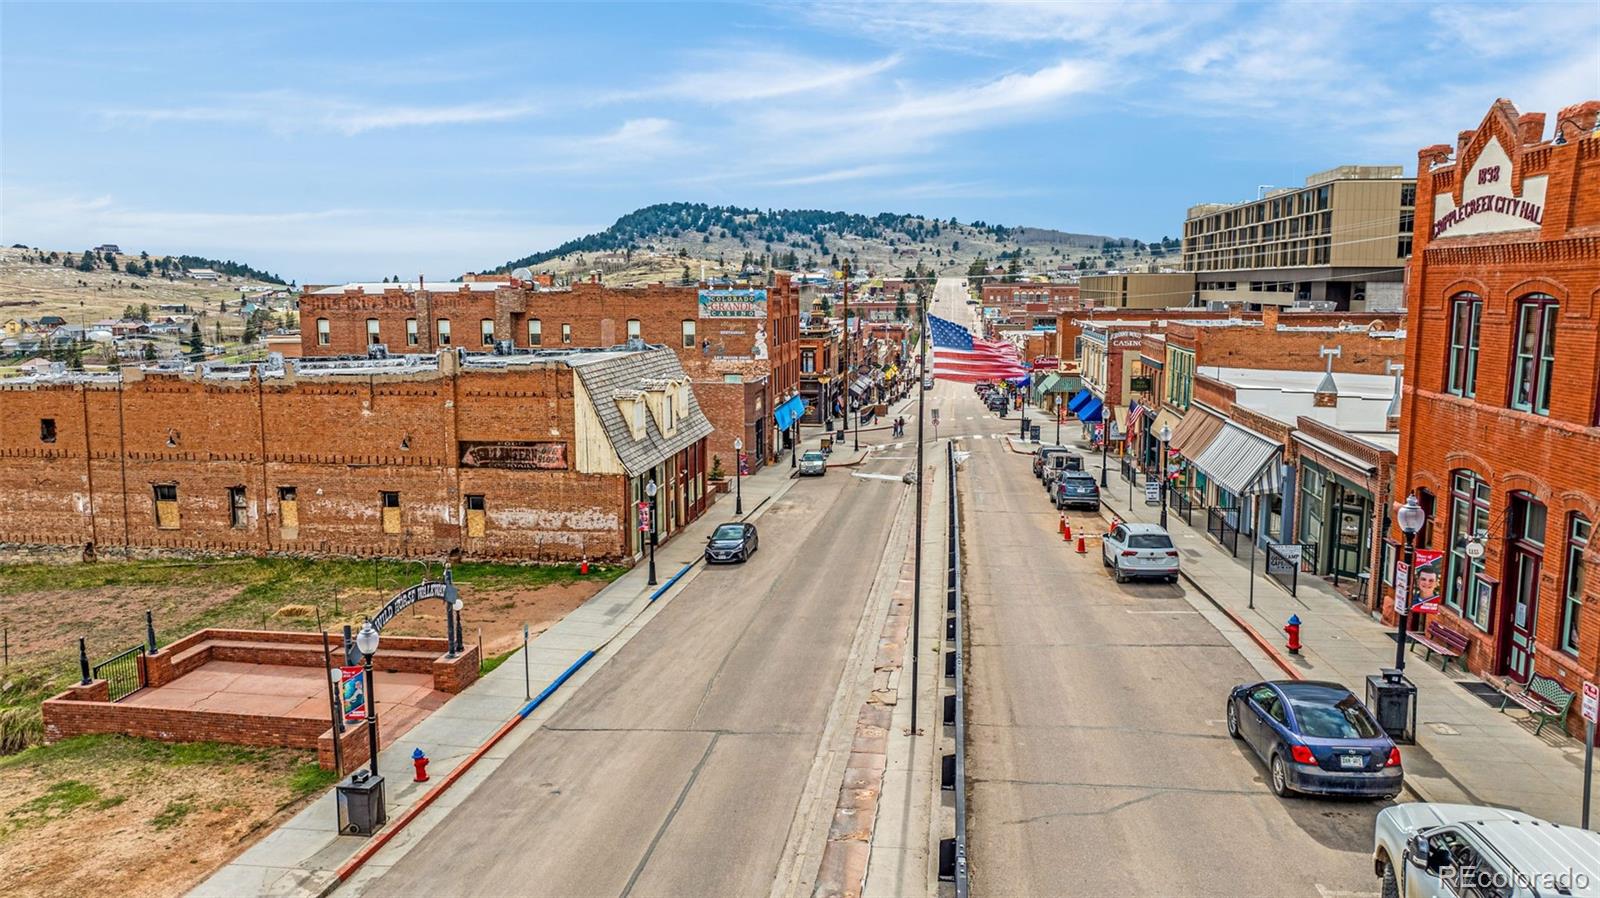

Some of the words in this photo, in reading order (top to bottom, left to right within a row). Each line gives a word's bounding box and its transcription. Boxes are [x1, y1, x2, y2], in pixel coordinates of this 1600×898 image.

[1478, 165, 1500, 185] 1898
[1433, 205, 1464, 239] CRIPPLE
[1464, 195, 1496, 218] CREEK
[1495, 196, 1521, 217] CITY
[1521, 201, 1542, 225] HALL
[710, 302, 753, 311] GRANDE
[374, 605, 393, 631] WILD
[394, 589, 416, 614] HORSE
